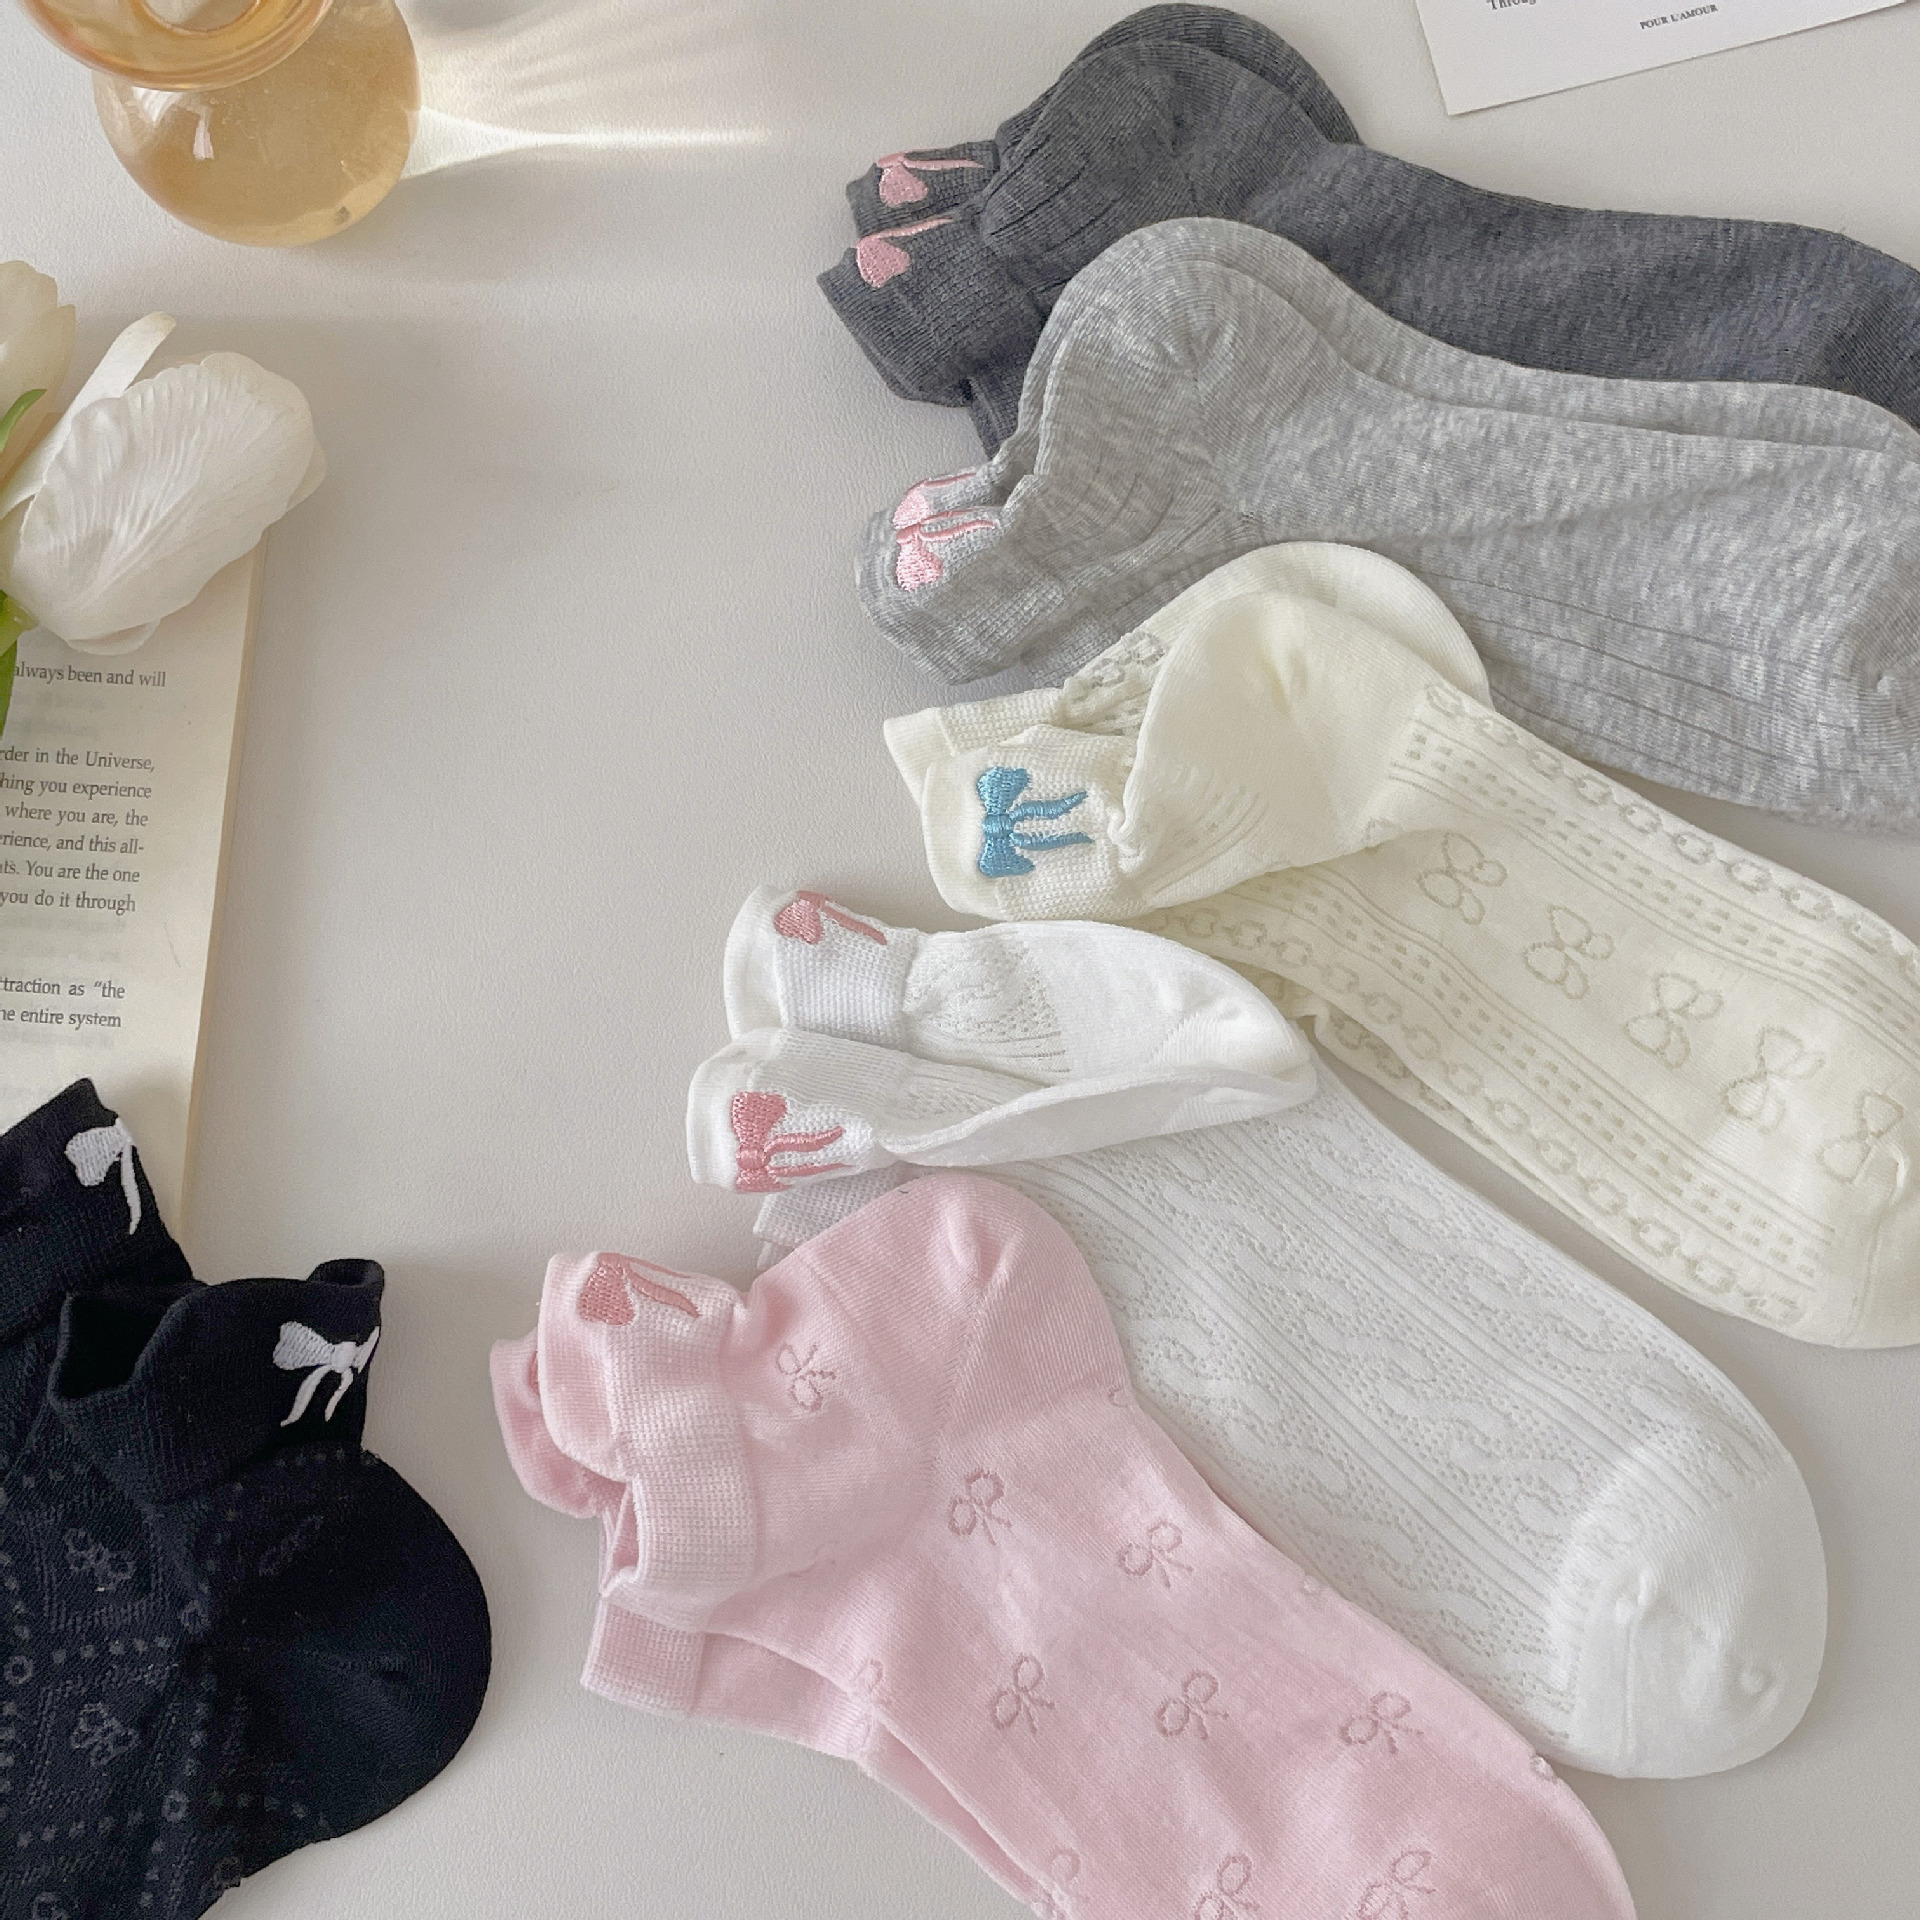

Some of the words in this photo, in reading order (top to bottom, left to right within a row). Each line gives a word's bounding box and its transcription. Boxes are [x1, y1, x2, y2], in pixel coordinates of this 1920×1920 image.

[1639, 16, 1669, 29] POUR
[1670, 4, 1718, 22] L'AMOUR
[68, 665, 102, 683] been
[106, 669, 134, 685] and
[139, 671, 166, 687] will
[35, 747, 49, 763] in
[56, 747, 79, 765] the
[86, 750, 155, 772] Universe,
[38, 780, 67, 797] you
[72, 781, 152, 800] experience
[5, 801, 52, 821] where
[56, 810, 86, 826] you
[91, 812, 119, 827] are,
[125, 808, 149, 826] the
[56, 835, 85, 851] and
[89, 834, 116, 853] this
[119, 838, 144, 854] all-
[26, 859, 53, 877] You
[57, 866, 81, 879] are
[85, 862, 109, 880] the
[112, 869, 140, 883] one
[0, 891, 28, 908] you
[34, 889, 54, 906] do
[59, 891, 70, 908] it
[76, 890, 136, 916] through
[68, 983, 85, 996] as
[93, 980, 126, 999] “the
[20, 1008, 64, 1025] entire
[68, 1012, 121, 1031] system
